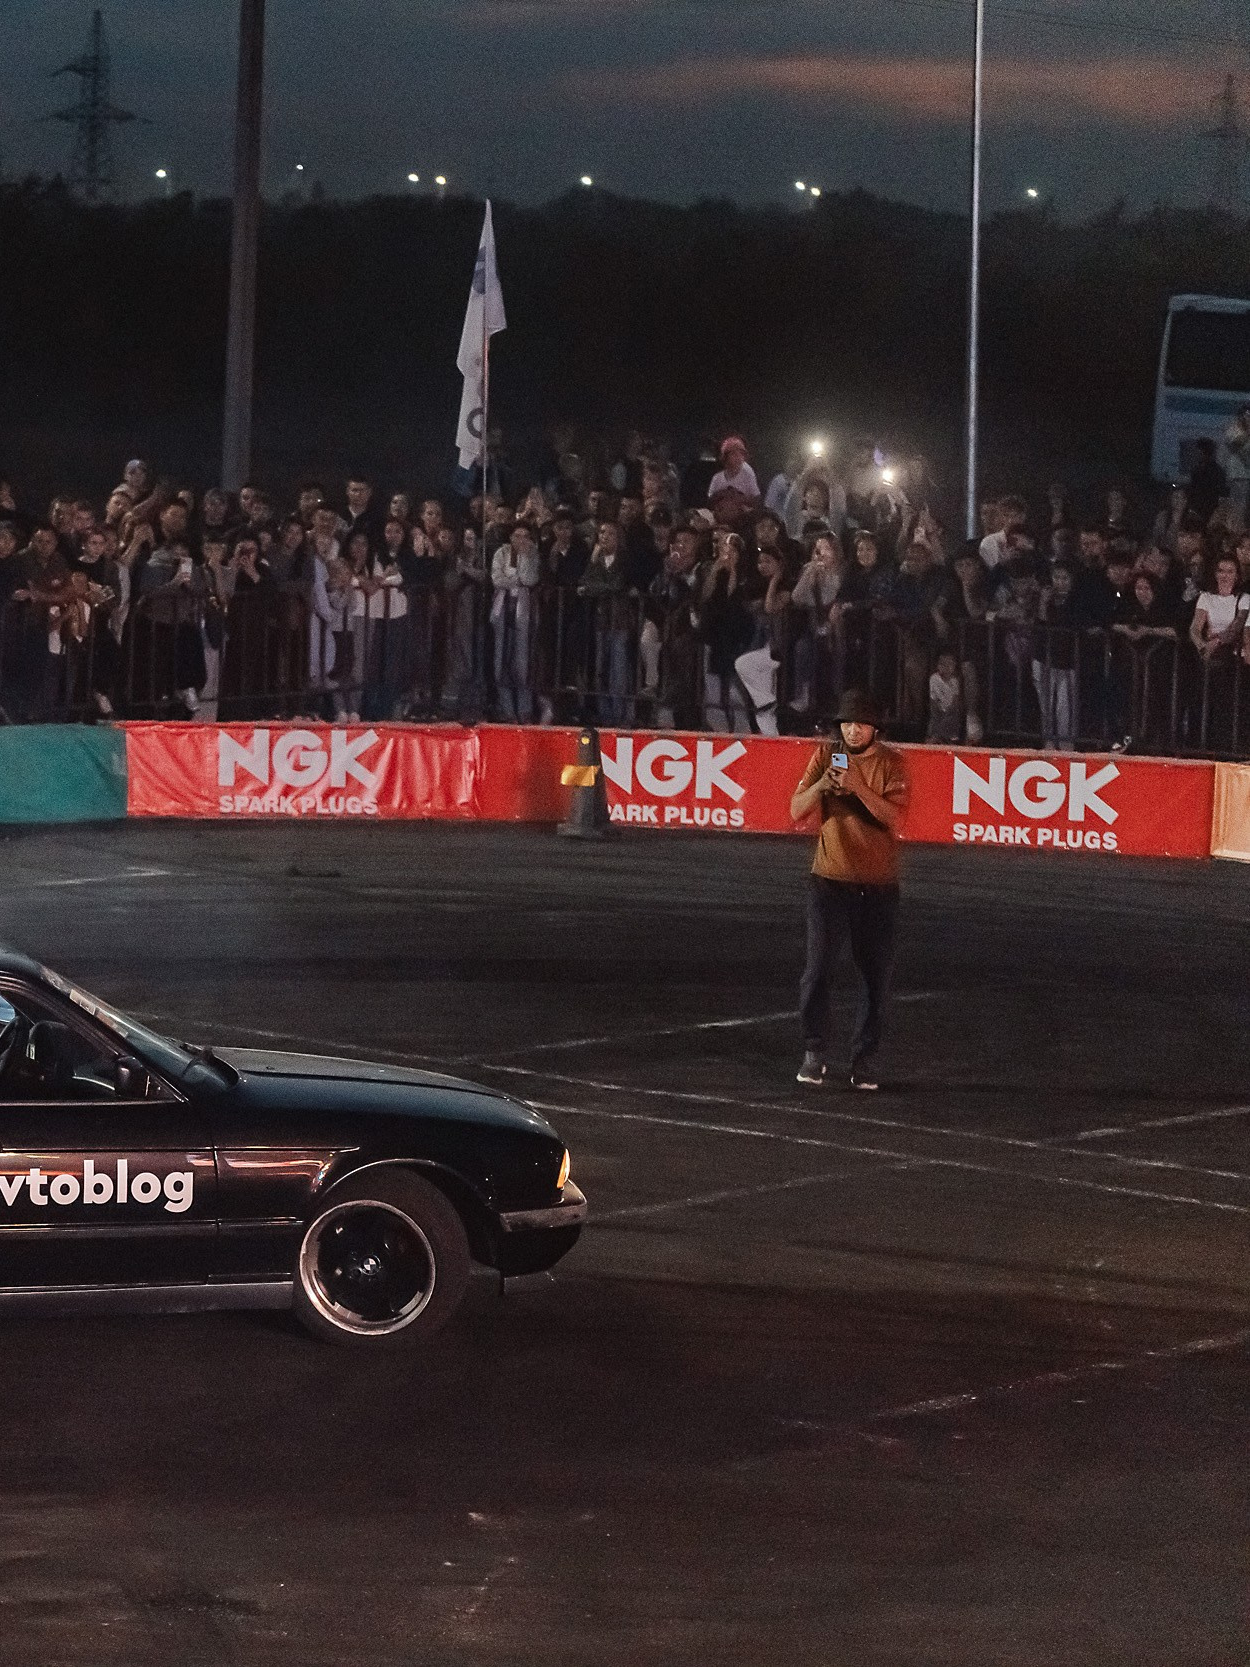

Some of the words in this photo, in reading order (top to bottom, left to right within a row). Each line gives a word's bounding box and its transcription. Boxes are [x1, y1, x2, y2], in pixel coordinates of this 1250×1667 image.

[218, 729, 379, 790] NGK
[952, 755, 1120, 825] NGK
[219, 795, 297, 815] SPARK
[301, 796, 378, 814] PLUGS
[608, 803, 658, 822] ARK
[664, 806, 745, 828] PLUGS
[953, 823, 1031, 845] SPARK
[1037, 827, 1118, 850] PLUGS
